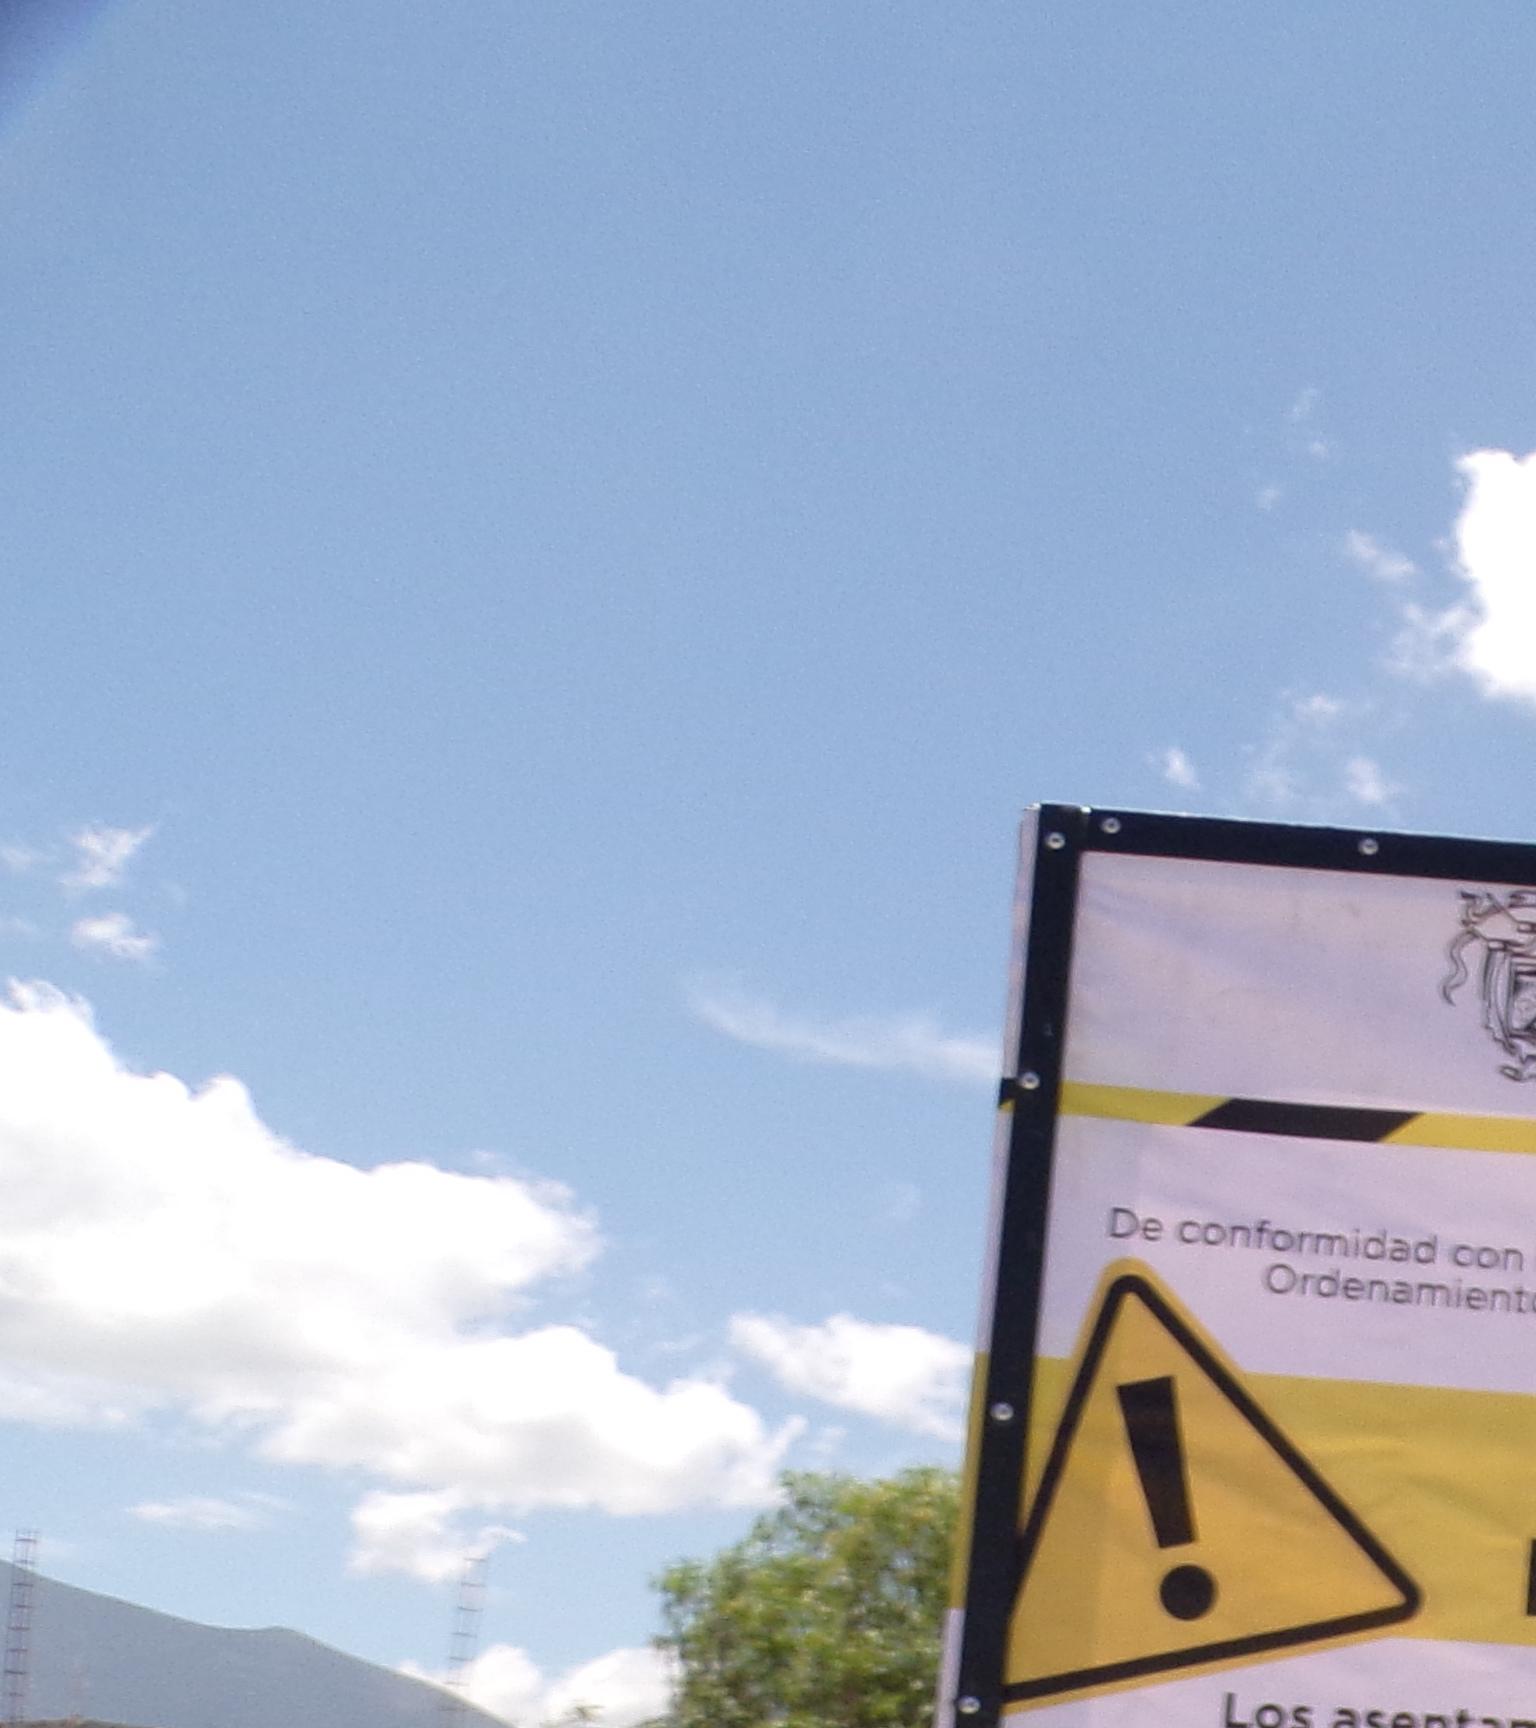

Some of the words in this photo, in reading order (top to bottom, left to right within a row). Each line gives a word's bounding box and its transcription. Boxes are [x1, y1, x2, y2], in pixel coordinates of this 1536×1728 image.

[1105, 1206, 1165, 1243] De
[1173, 1217, 1440, 1267] conformidad
[1445, 1242, 1526, 1273] con
